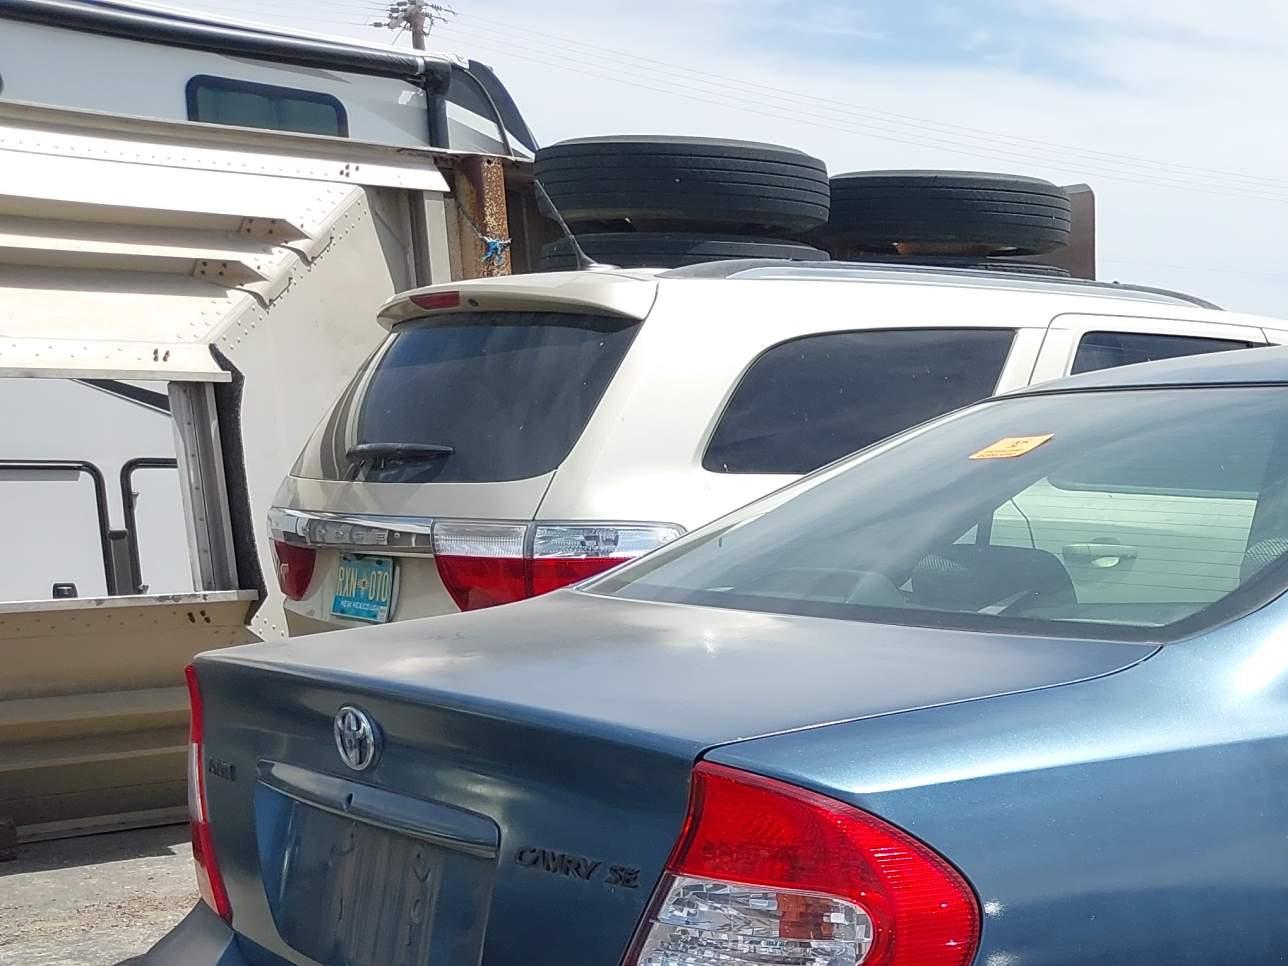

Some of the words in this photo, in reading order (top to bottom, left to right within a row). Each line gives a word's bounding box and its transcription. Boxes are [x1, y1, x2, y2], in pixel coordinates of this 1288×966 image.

[336, 566, 358, 599] RXN
[515, 847, 602, 881] CAMRY
[604, 864, 641, 889] SE
